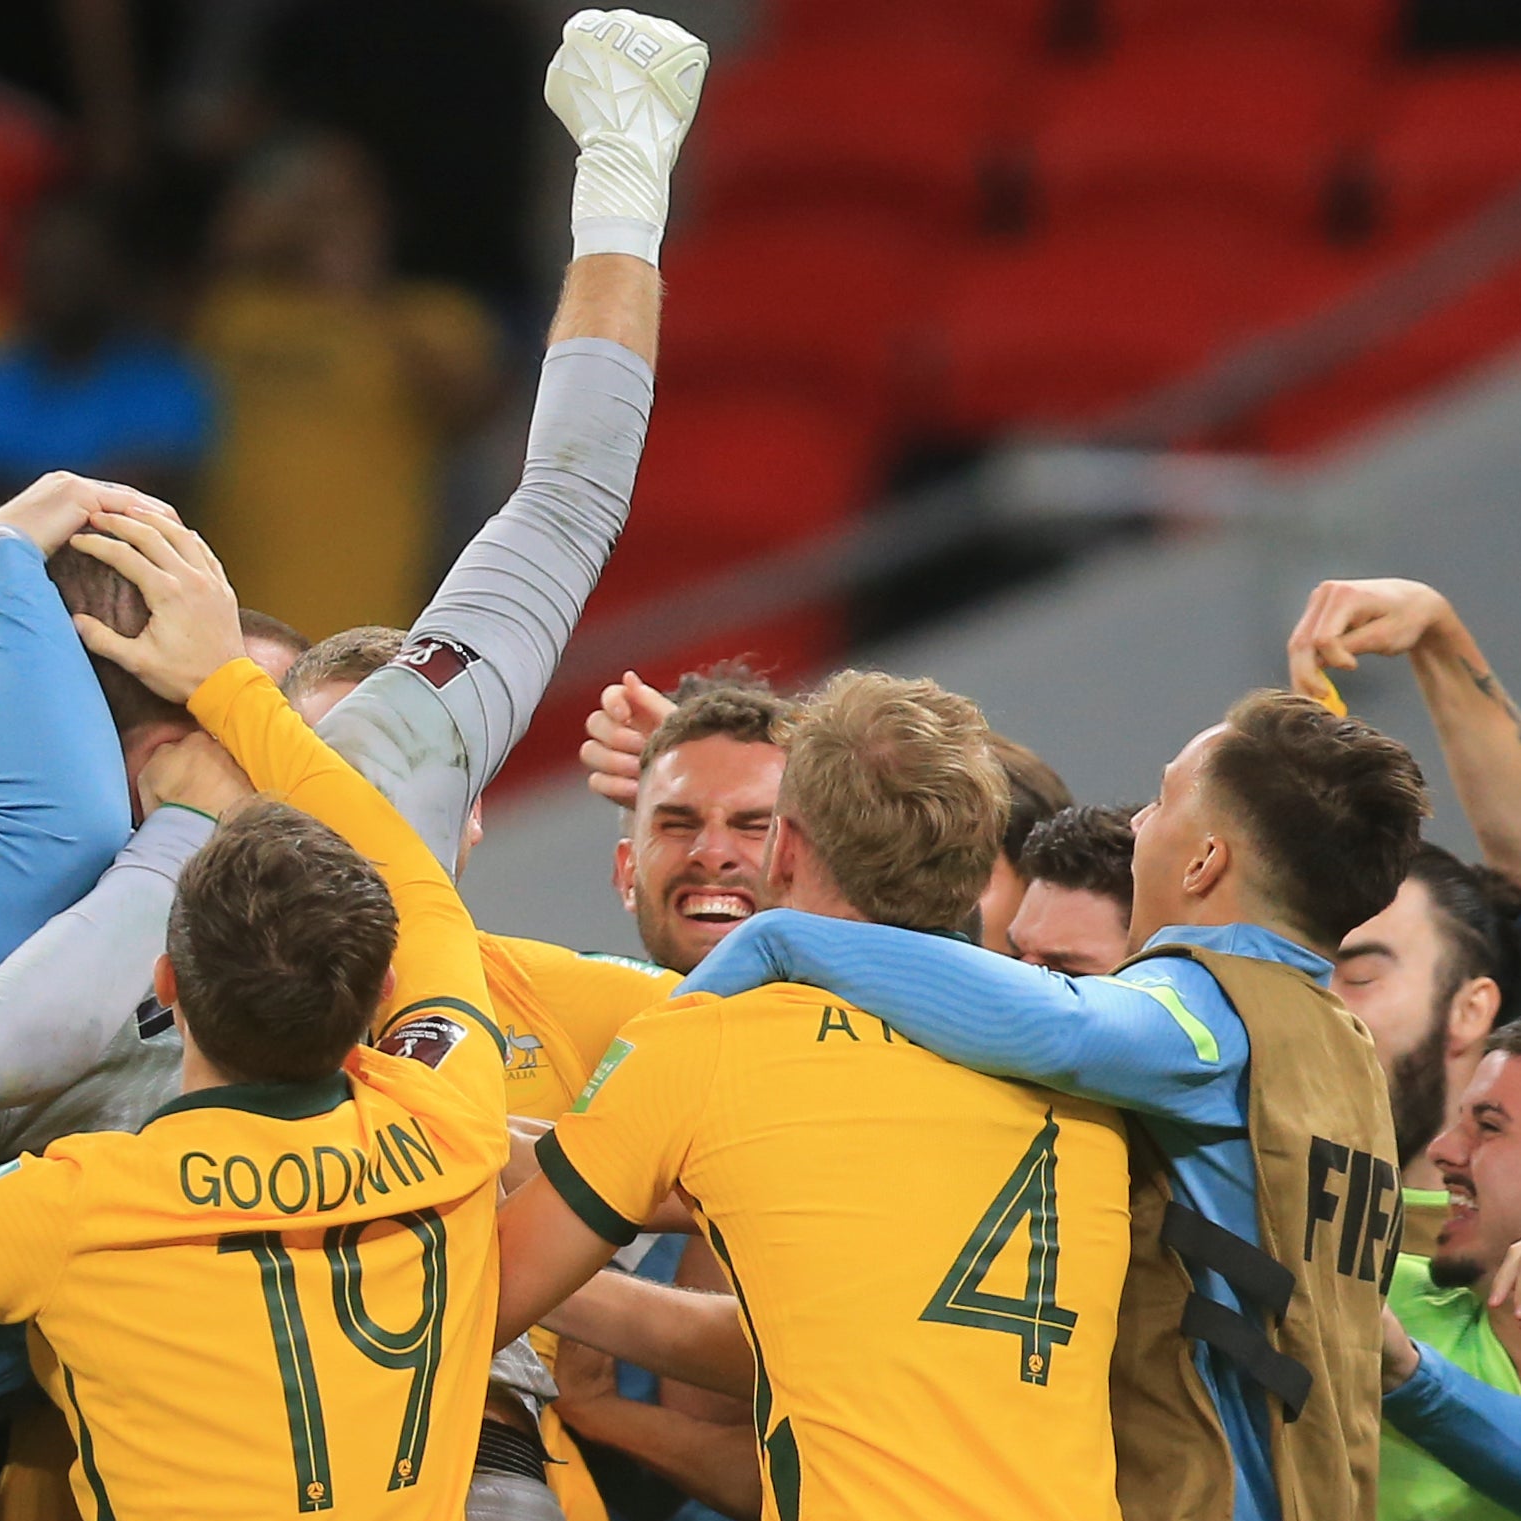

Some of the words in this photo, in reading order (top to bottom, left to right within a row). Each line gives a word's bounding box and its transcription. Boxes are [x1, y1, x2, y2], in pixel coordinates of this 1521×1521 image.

[180, 1116, 444, 1214] GOODWIN
[918, 1104, 1079, 1387] 4
[217, 1206, 448, 1513] 19
